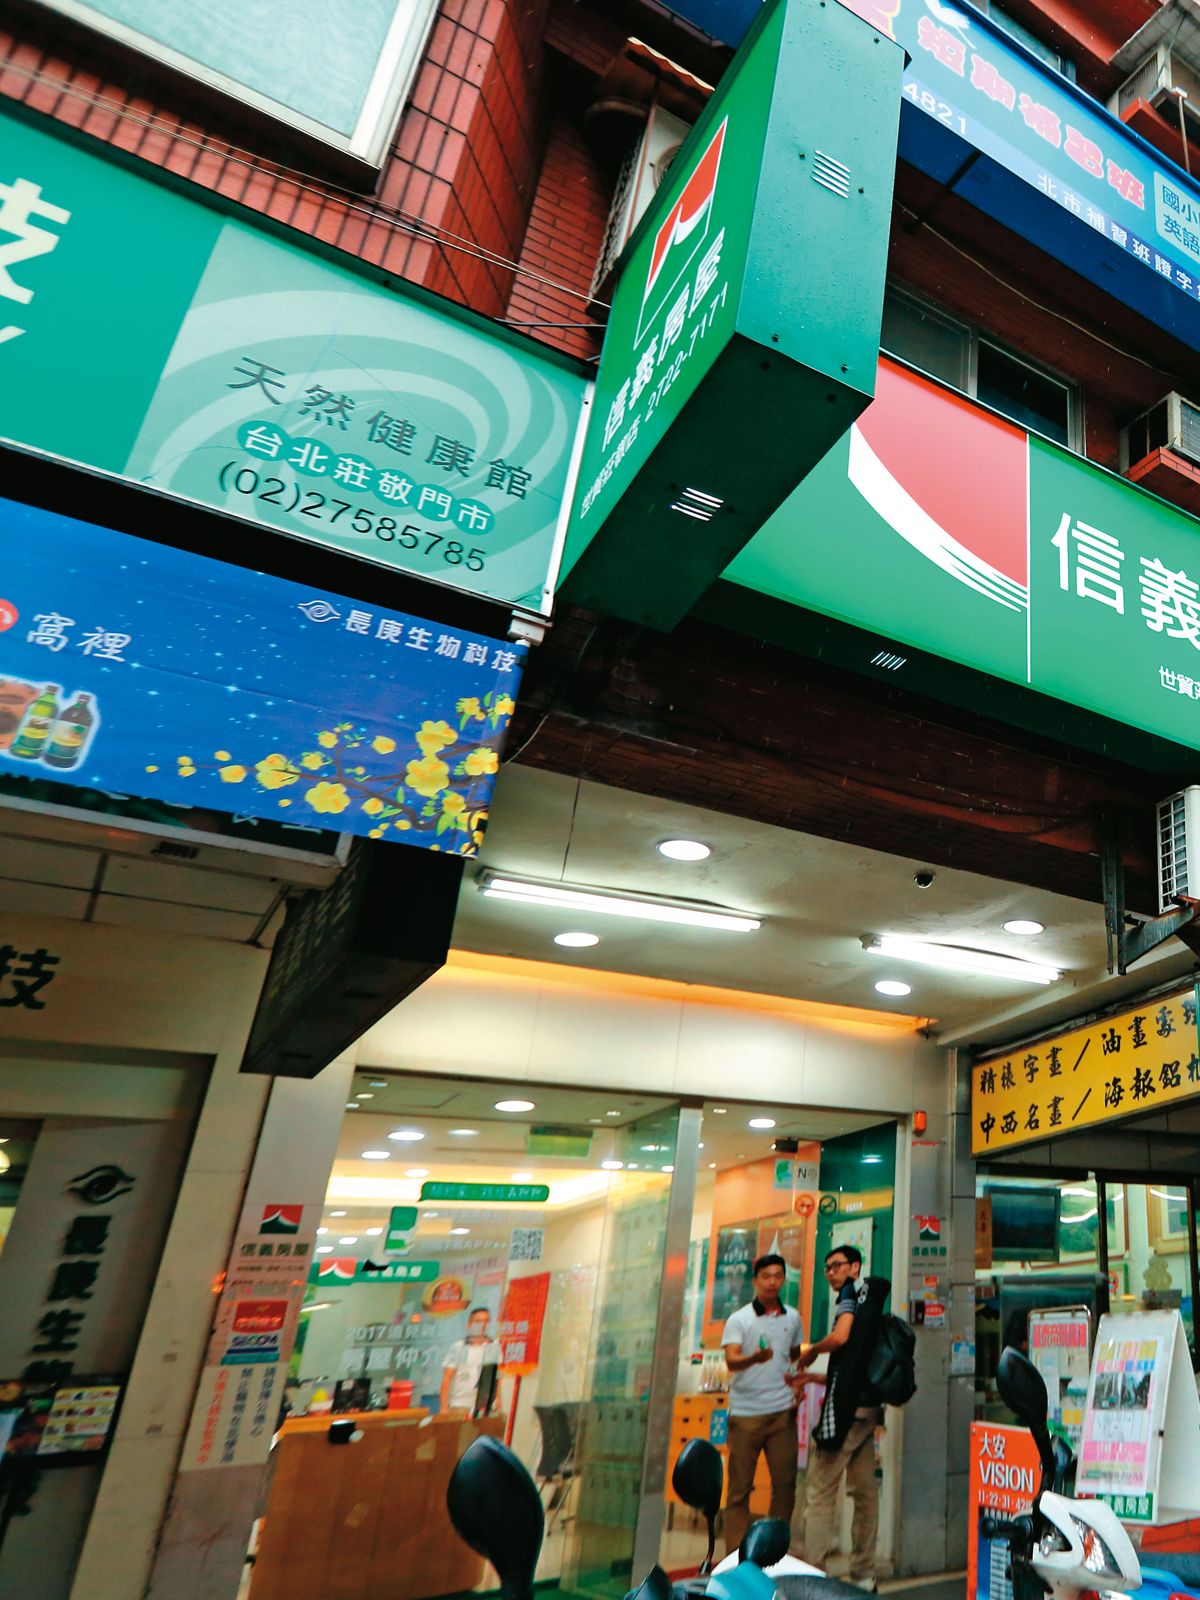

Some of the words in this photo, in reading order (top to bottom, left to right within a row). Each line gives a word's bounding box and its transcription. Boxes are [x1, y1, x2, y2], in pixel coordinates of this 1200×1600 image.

[602, 226, 726, 452] 信義房屋
[645, 281, 729, 424] 2722-7171
[226, 357, 534, 500] 天然健康館
[243, 424, 493, 533] 台北莊敬門市
[218, 459, 486, 573] (02)27585785
[346, 609, 519, 673] 長庚生物科技
[978, 1459, 1035, 1494] VISION
[979, 1431, 1006, 1460] 大安
